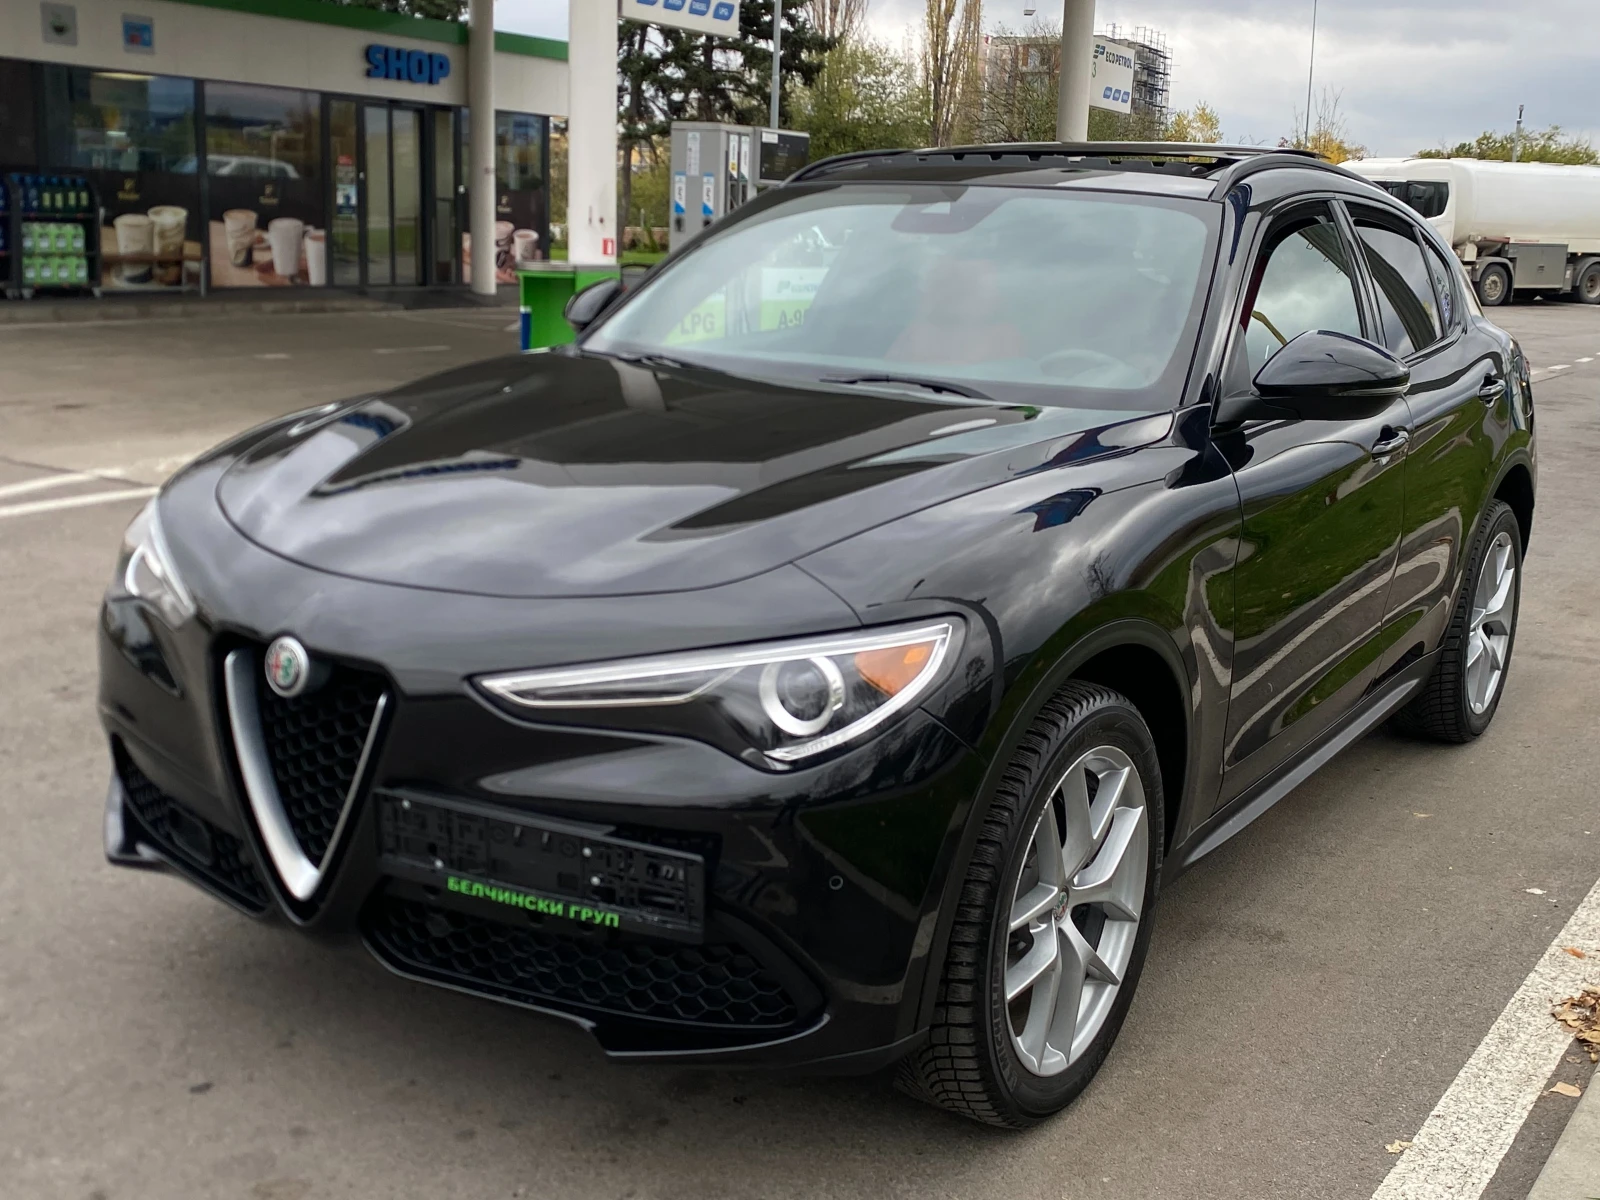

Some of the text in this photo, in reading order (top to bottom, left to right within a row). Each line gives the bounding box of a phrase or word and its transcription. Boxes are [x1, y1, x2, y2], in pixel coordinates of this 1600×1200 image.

[366, 44, 450, 85] SHOP
[681, 313, 715, 335] LPG
[777, 308, 805, 330] A-9
[447, 876, 620, 928] БЕЛЧИНСКИ ГРУП
